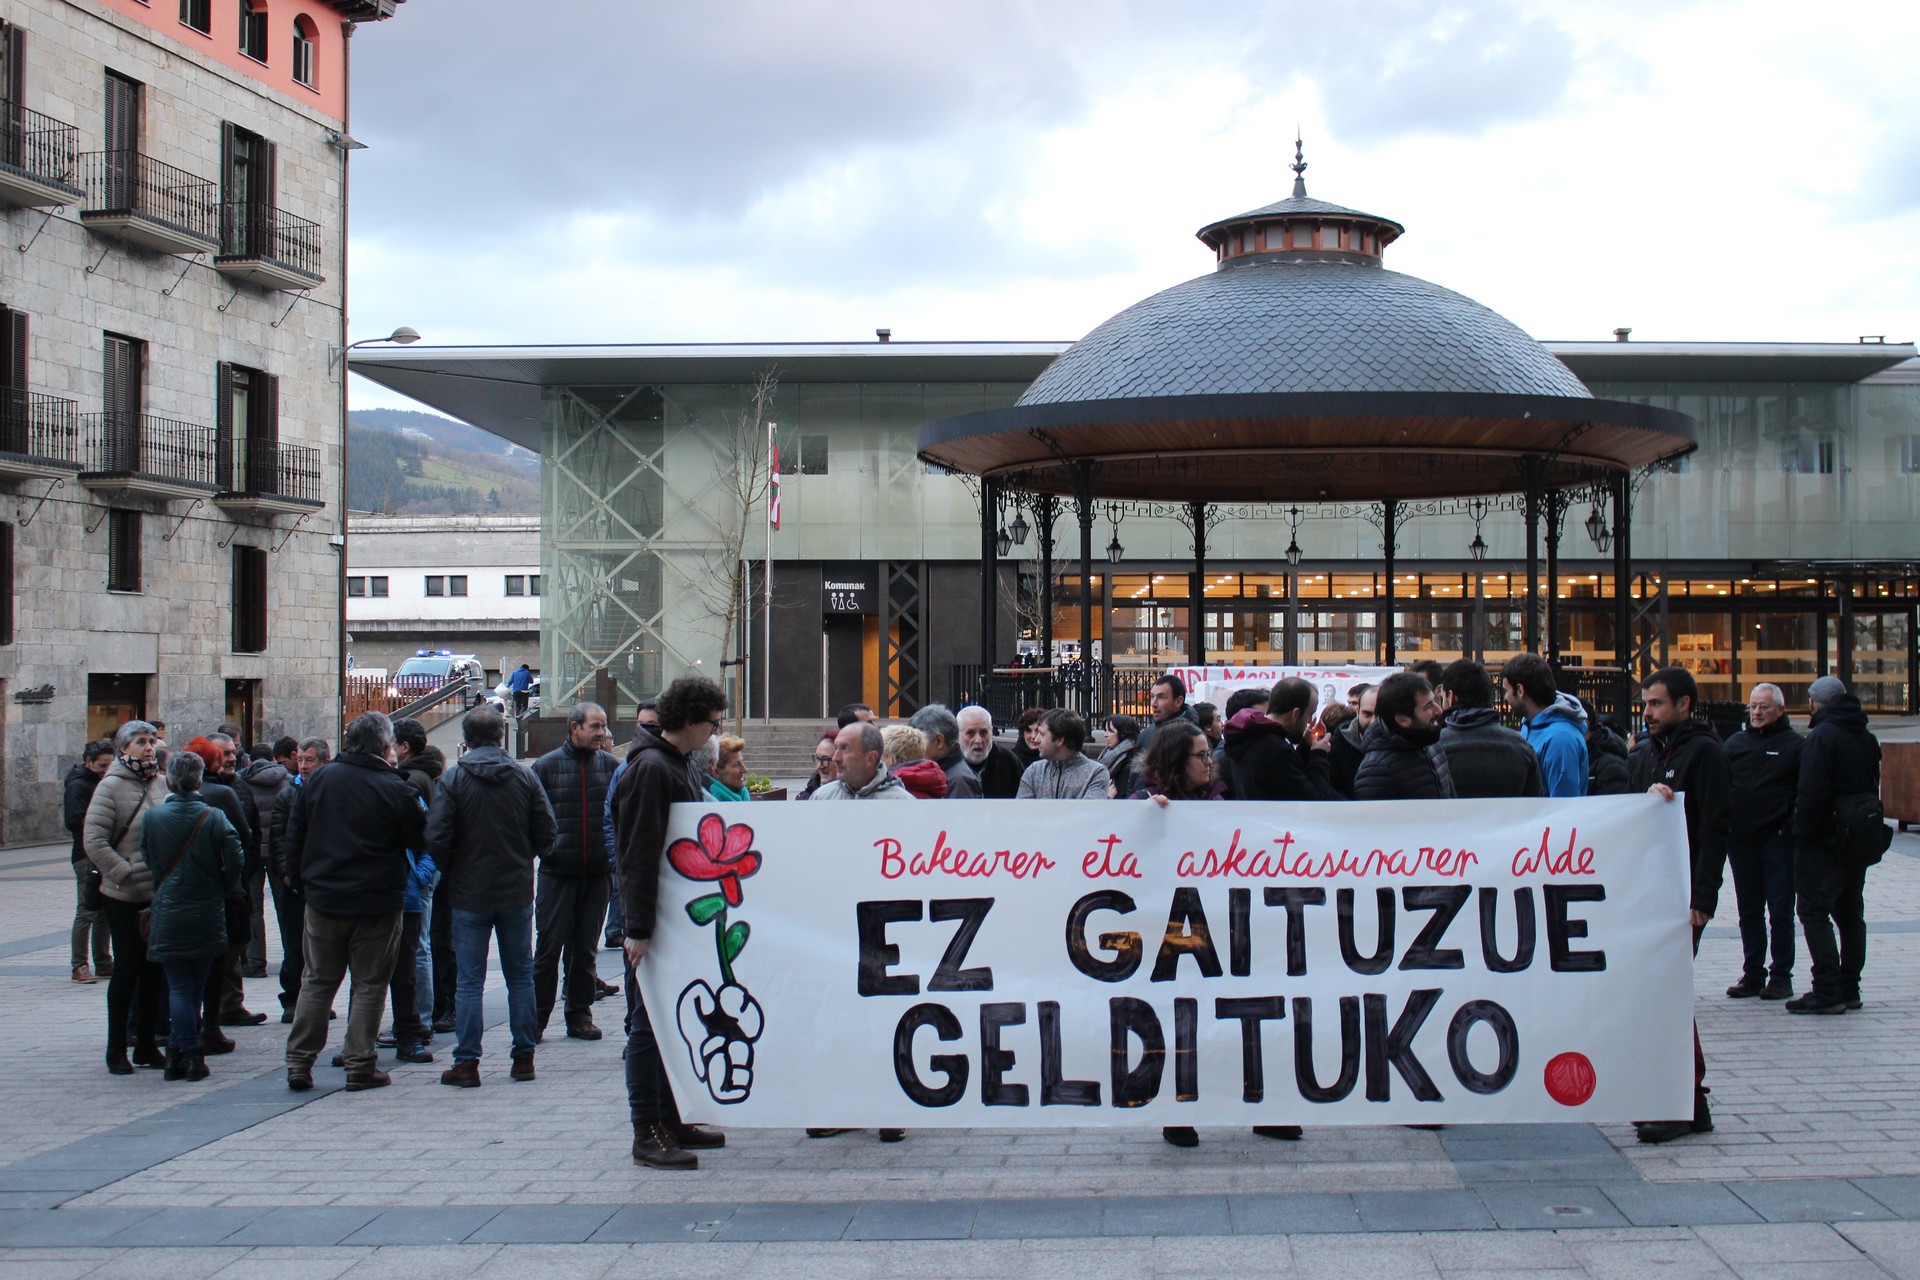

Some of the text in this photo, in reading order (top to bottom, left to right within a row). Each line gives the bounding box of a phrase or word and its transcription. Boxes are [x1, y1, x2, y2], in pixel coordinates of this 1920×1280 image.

[824, 580, 866, 590] Komunak
[873, 826, 1596, 879] Bakearen eta askatasunaren alde
[856, 884, 1607, 998] EZ GAITUZUE
